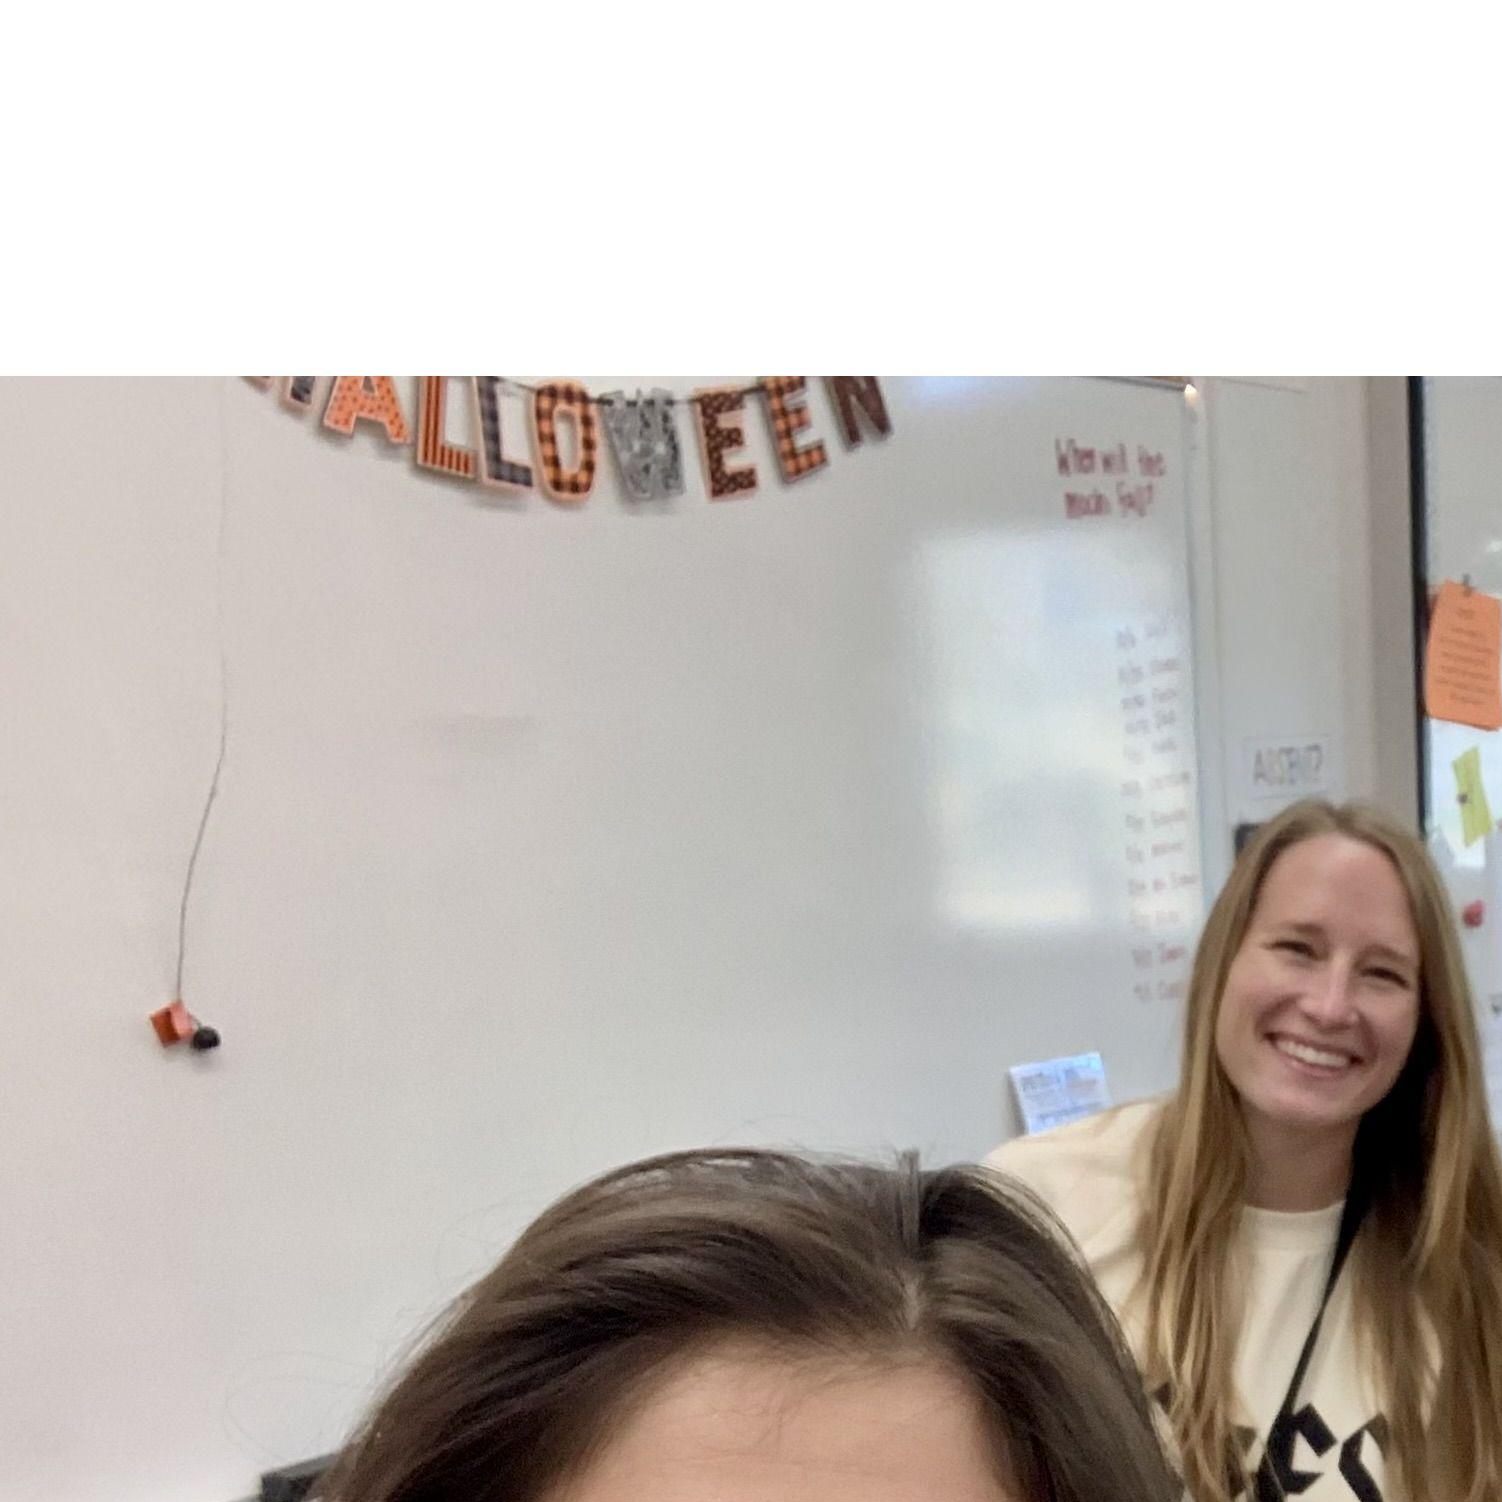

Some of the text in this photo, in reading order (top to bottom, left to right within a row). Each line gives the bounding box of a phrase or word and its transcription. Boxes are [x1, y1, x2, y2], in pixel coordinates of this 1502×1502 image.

[244, 377, 893, 499] ALLOWEEN
[1102, 443, 1128, 474] will
[1138, 444, 1167, 477] the
